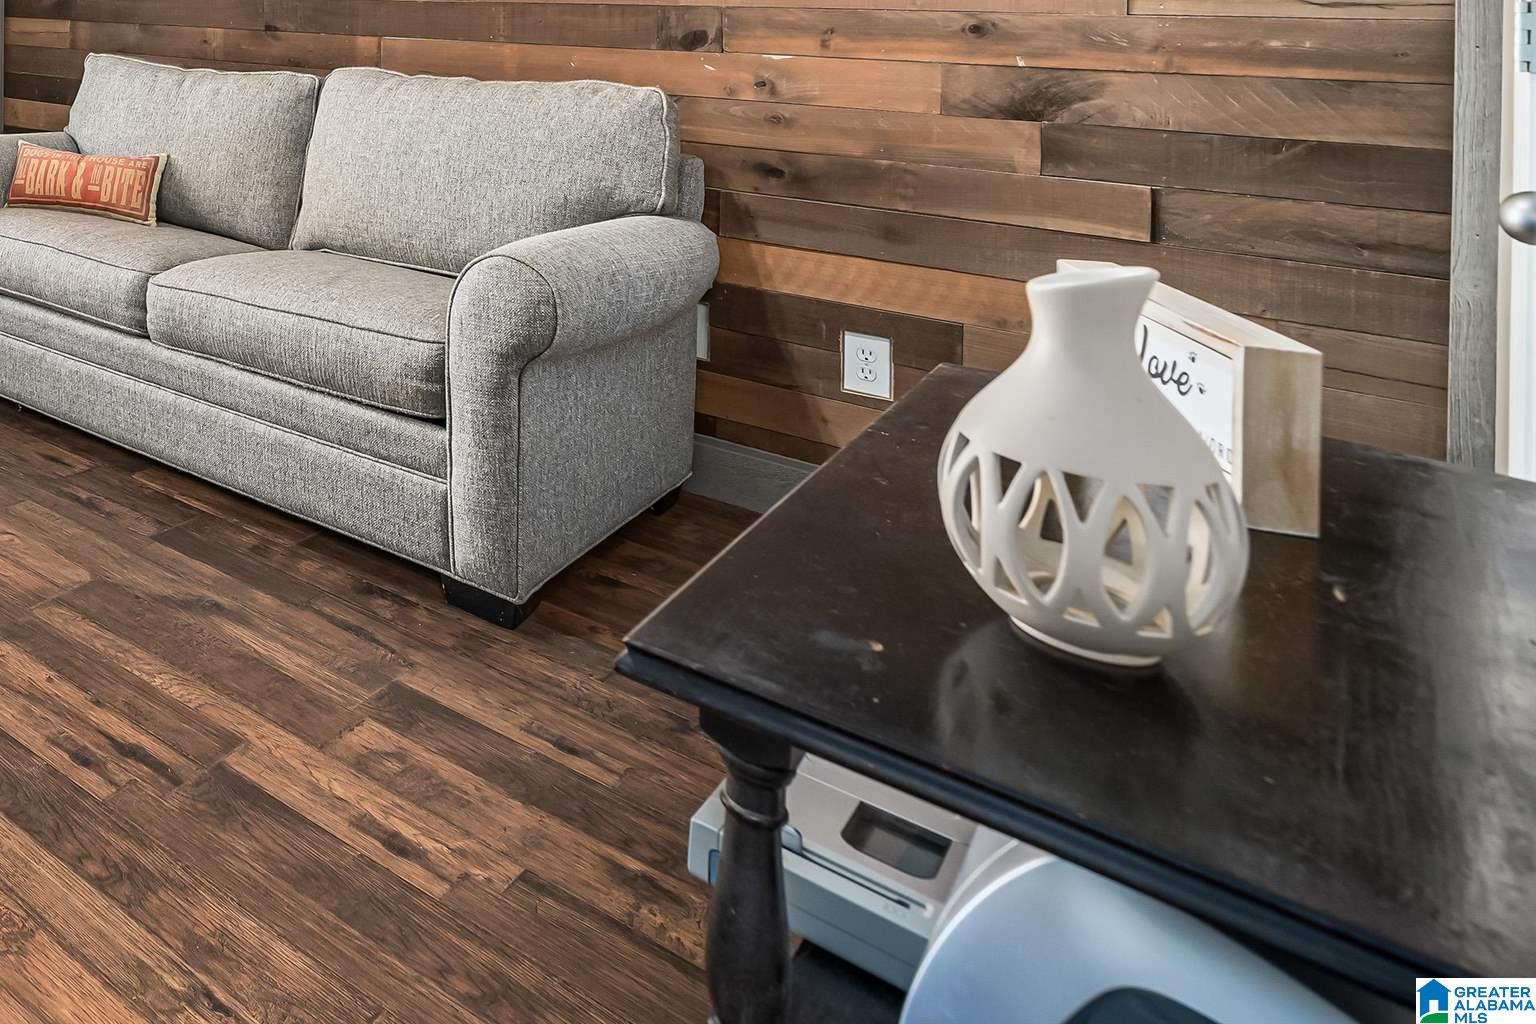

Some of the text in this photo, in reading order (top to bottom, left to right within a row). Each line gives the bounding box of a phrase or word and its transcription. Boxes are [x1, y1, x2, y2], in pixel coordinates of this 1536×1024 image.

[23, 148, 48, 158] DOGS
[89, 156, 125, 166] HOUSE
[129, 160, 147, 169] ARE
[25, 159, 70, 196] BARK
[71, 162, 86, 200] &
[100, 166, 147, 209] BITE
